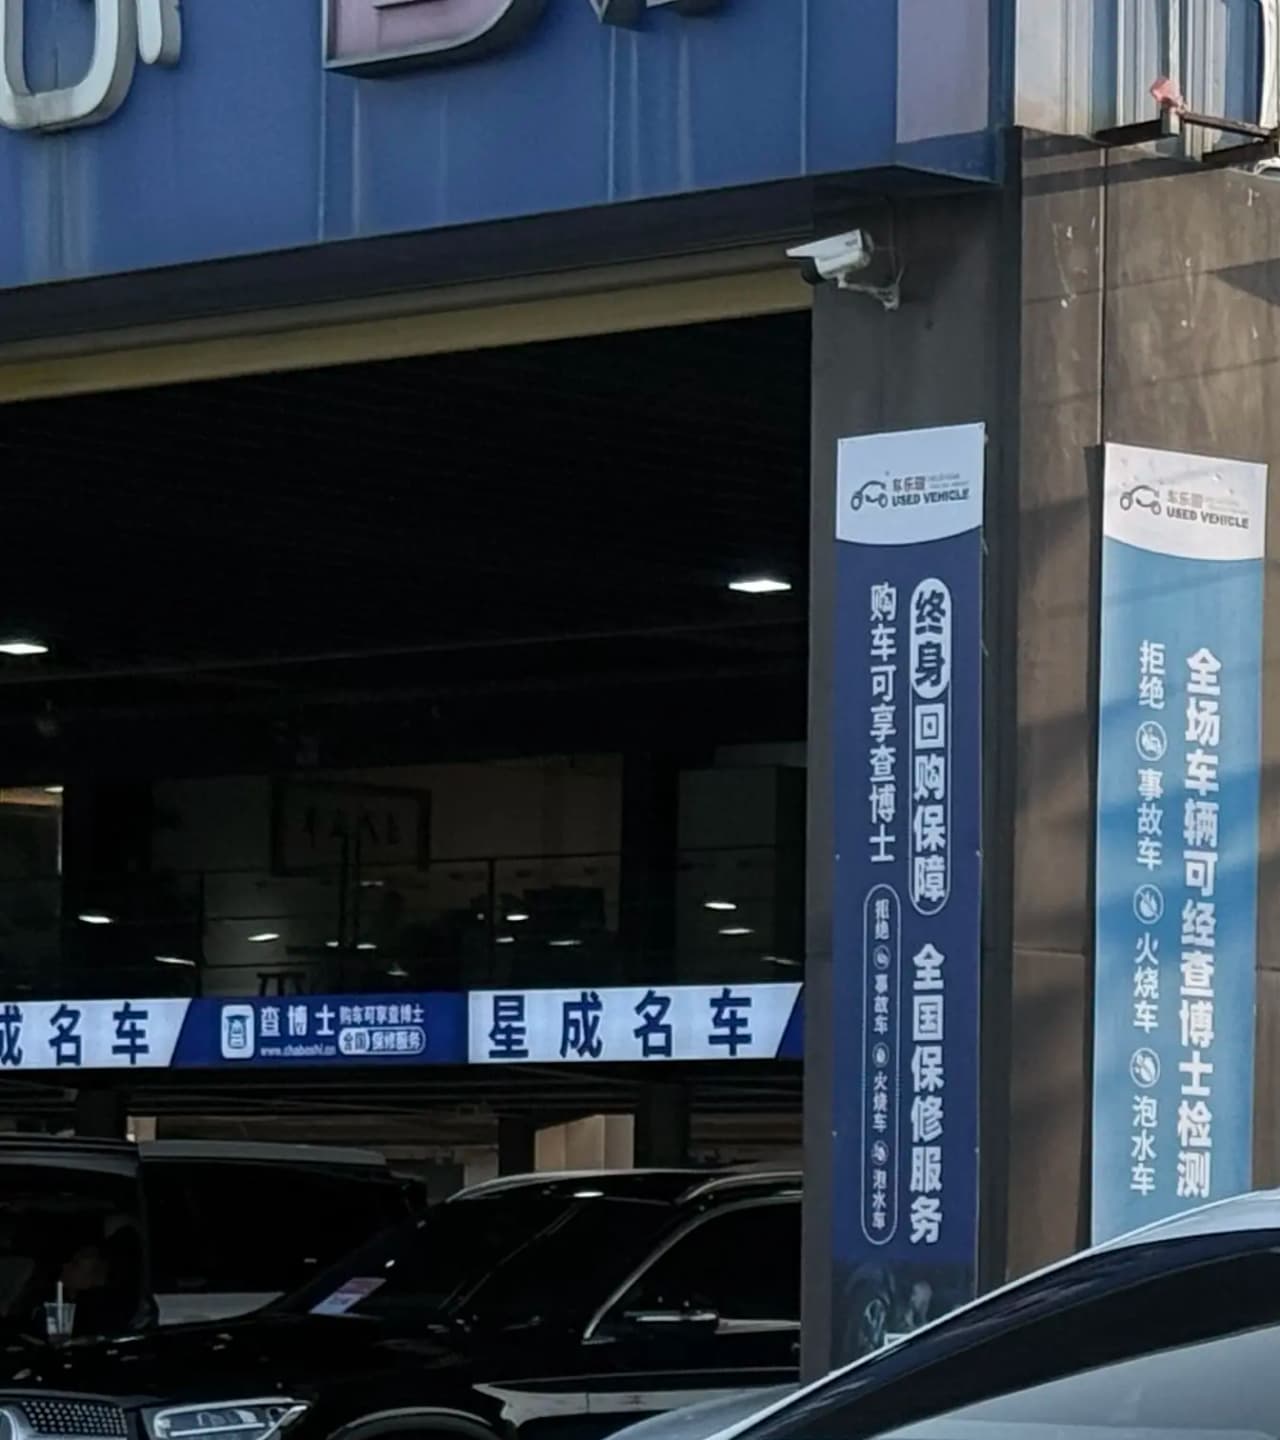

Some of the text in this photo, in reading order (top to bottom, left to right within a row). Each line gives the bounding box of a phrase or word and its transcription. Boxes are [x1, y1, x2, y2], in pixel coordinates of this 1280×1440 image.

[891, 488, 969, 507] USED VEHICLE
[1166, 506, 1249, 530] USED VEHICLE
[869, 578, 898, 862] 购车可享查博士
[909, 589, 946, 1244] 终身回购保障 全国保修服务
[1129, 639, 1166, 1197] 拒绝 事故车 火烧车 泡水车
[1175, 647, 1222, 1199] 全场车辆可经查博士检测
[259, 1003, 336, 1038] 查博士
[488, 987, 753, 1059] 星成名车
